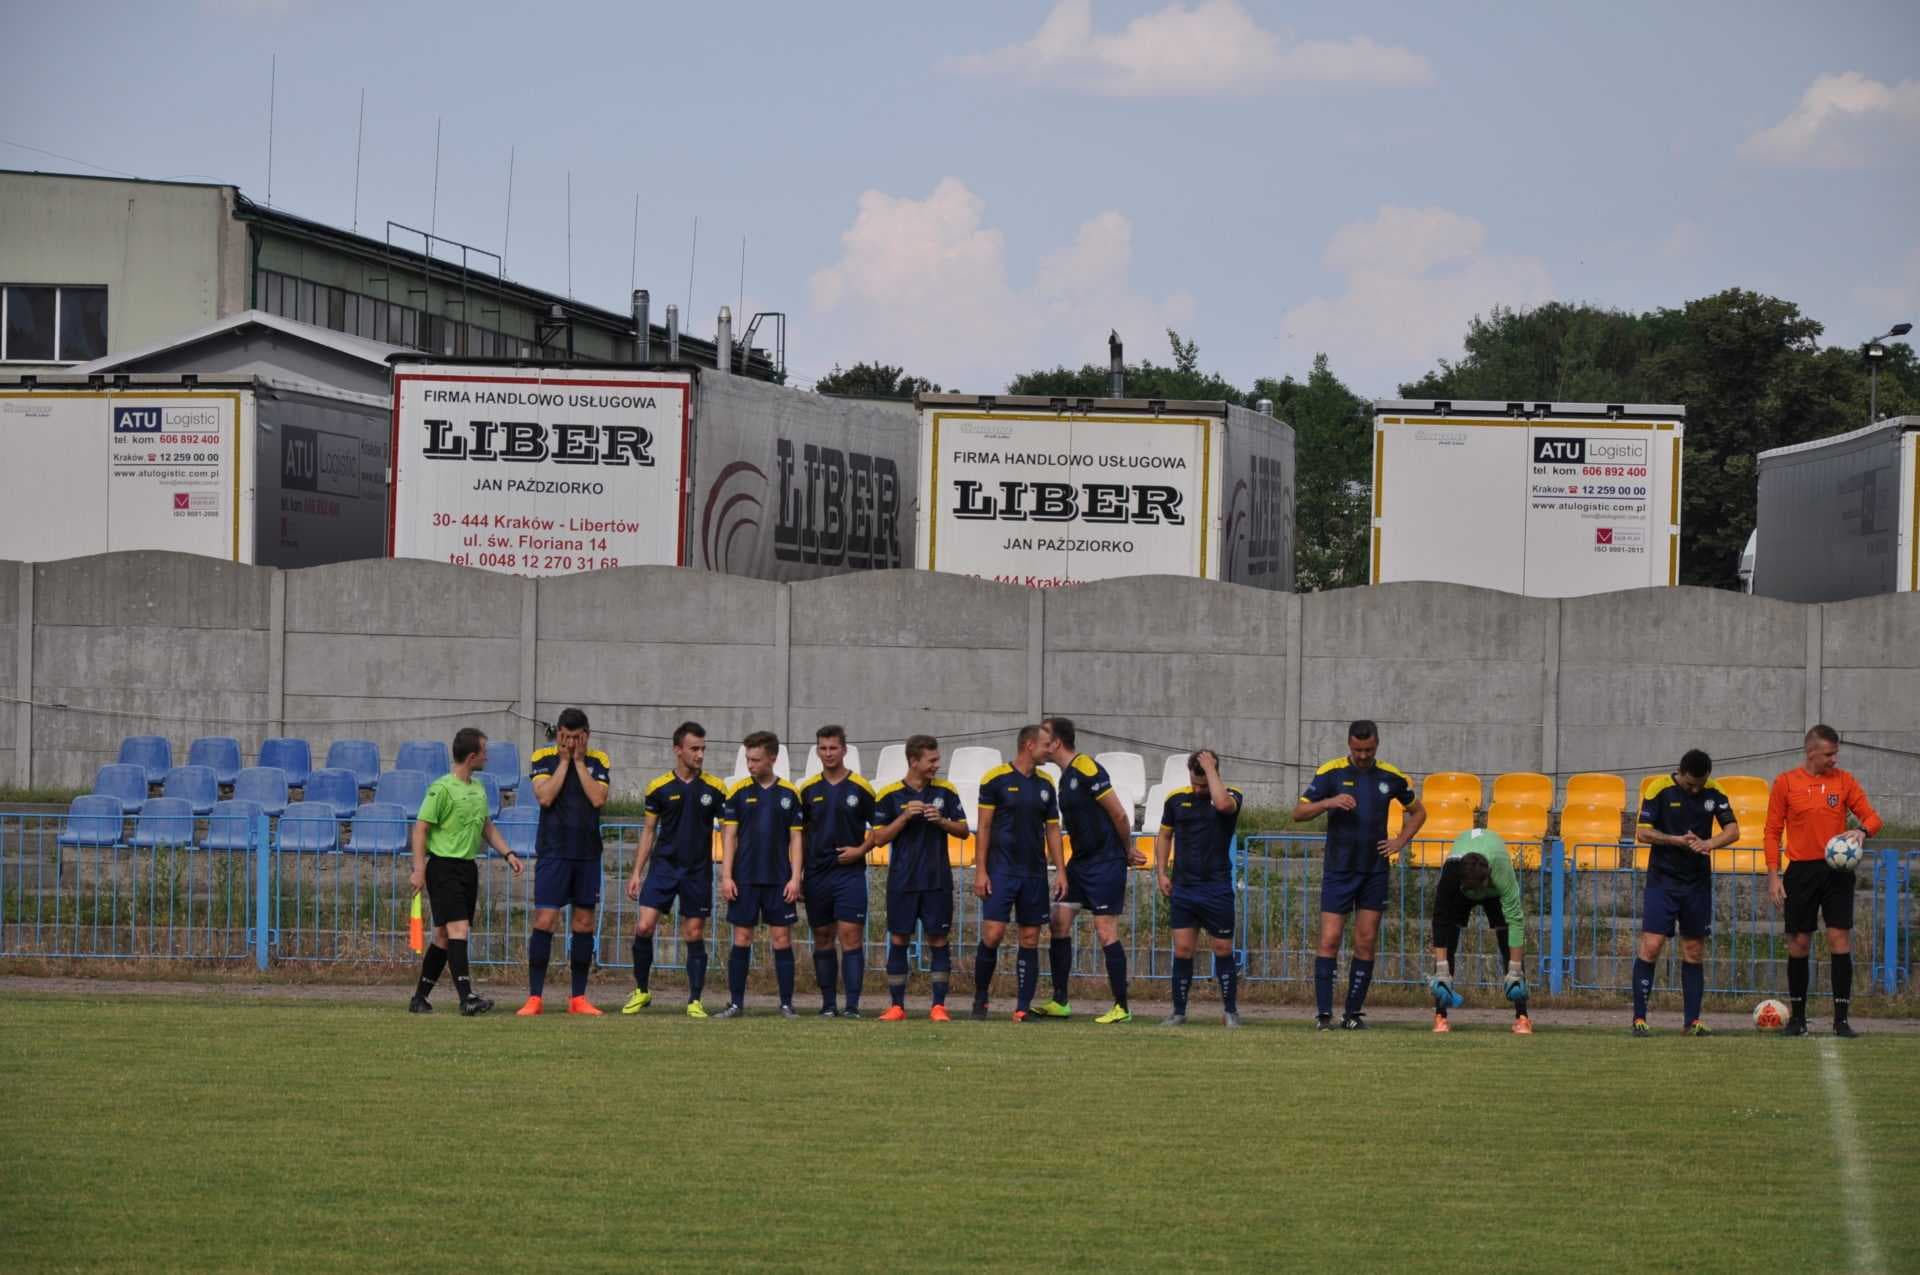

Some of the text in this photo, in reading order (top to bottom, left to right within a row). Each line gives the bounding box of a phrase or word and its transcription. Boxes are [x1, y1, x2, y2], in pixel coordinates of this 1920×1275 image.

[424, 390, 656, 409] FIRMA HANDLOWO USŁUGOWA
[120, 412, 215, 428] ATU Logistic
[160, 435, 178, 444] 606
[180, 435, 199, 444] 892
[201, 435, 220, 444] 400
[423, 419, 655, 467] LIBER
[160, 453, 171, 461] 12
[174, 453, 191, 461] 259
[193, 453, 205, 461] 00
[207, 453, 219, 461] 00
[286, 439, 314, 479] ATU
[1540, 442, 1642, 459] ATU Logistic
[953, 451, 1186, 469] FIRMA HANDLOWO USŁUGOWA
[1583, 466, 1601, 476] 606
[1605, 467, 1624, 476] 892
[1627, 467, 1647, 477] 400
[473, 477, 604, 495] JAN PAŹDZIORKO
[1583, 486, 1595, 494] 12
[1598, 486, 1615, 495] 259
[1618, 486, 1630, 495] 00
[1633, 487, 1646, 495] 00
[774, 438, 900, 569] LIBER
[953, 480, 1185, 526] LIBER
[461, 514, 488, 527] 444
[495, 515, 554, 530] Kraków
[570, 518, 639, 533] Libertów
[464, 534, 607, 551] ul. św. Floriana 14
[1003, 537, 1134, 553] JAN PAŹDZIORKO
[479, 553, 515, 567] 0048
[524, 555, 539, 568] 12
[544, 556, 571, 569] 270
[577, 557, 593, 570] 31
[601, 558, 618, 569] 68
